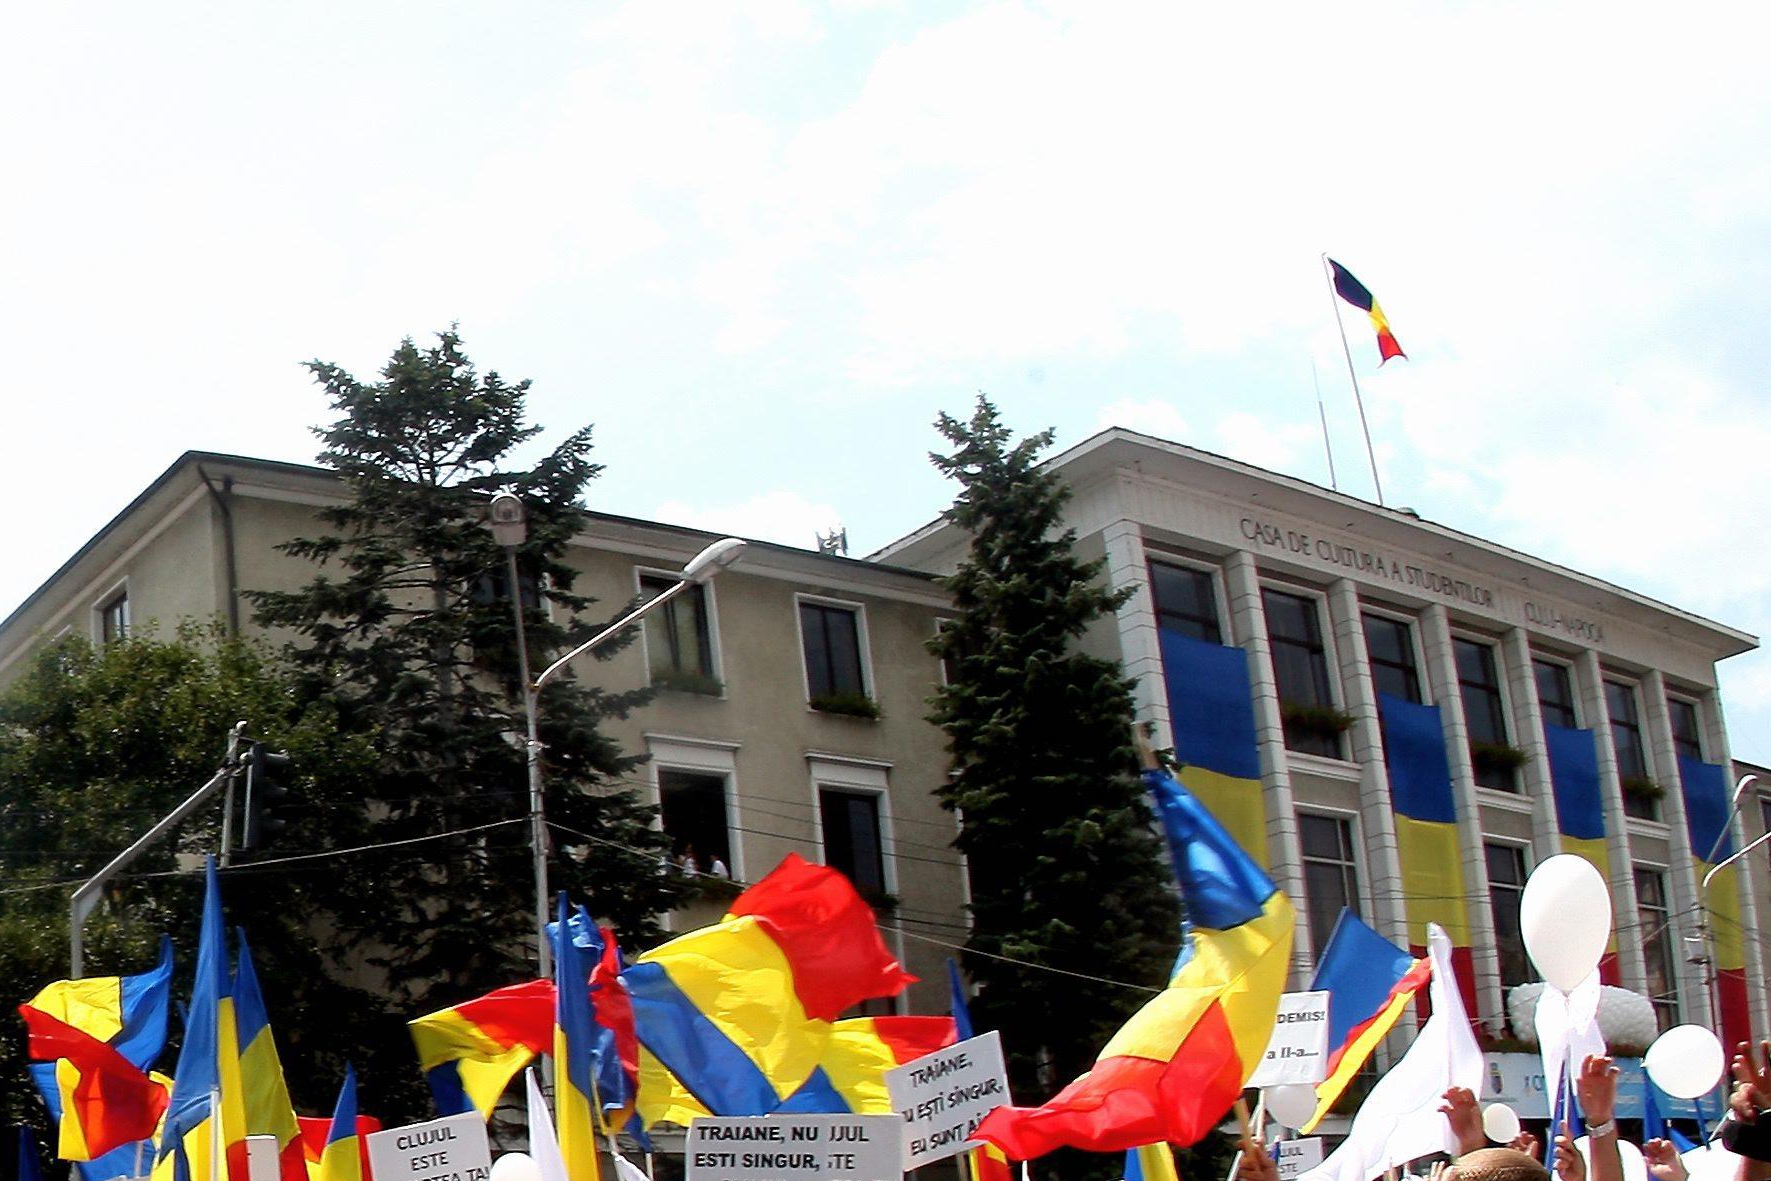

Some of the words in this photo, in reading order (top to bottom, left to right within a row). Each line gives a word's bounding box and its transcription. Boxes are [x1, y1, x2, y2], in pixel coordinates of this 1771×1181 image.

[1240, 518, 1286, 549] CASA
[1288, 531, 1311, 555] DE
[1390, 562, 1404, 583] A
[396, 1126, 457, 1151] CLUJUL
[697, 1126, 786, 1144] TRAIANE,
[791, 1126, 818, 1141] NU
[410, 1151, 450, 1172] ESTE
[694, 1152, 735, 1168] ESTI
[741, 1153, 820, 1172] SINGUR,
